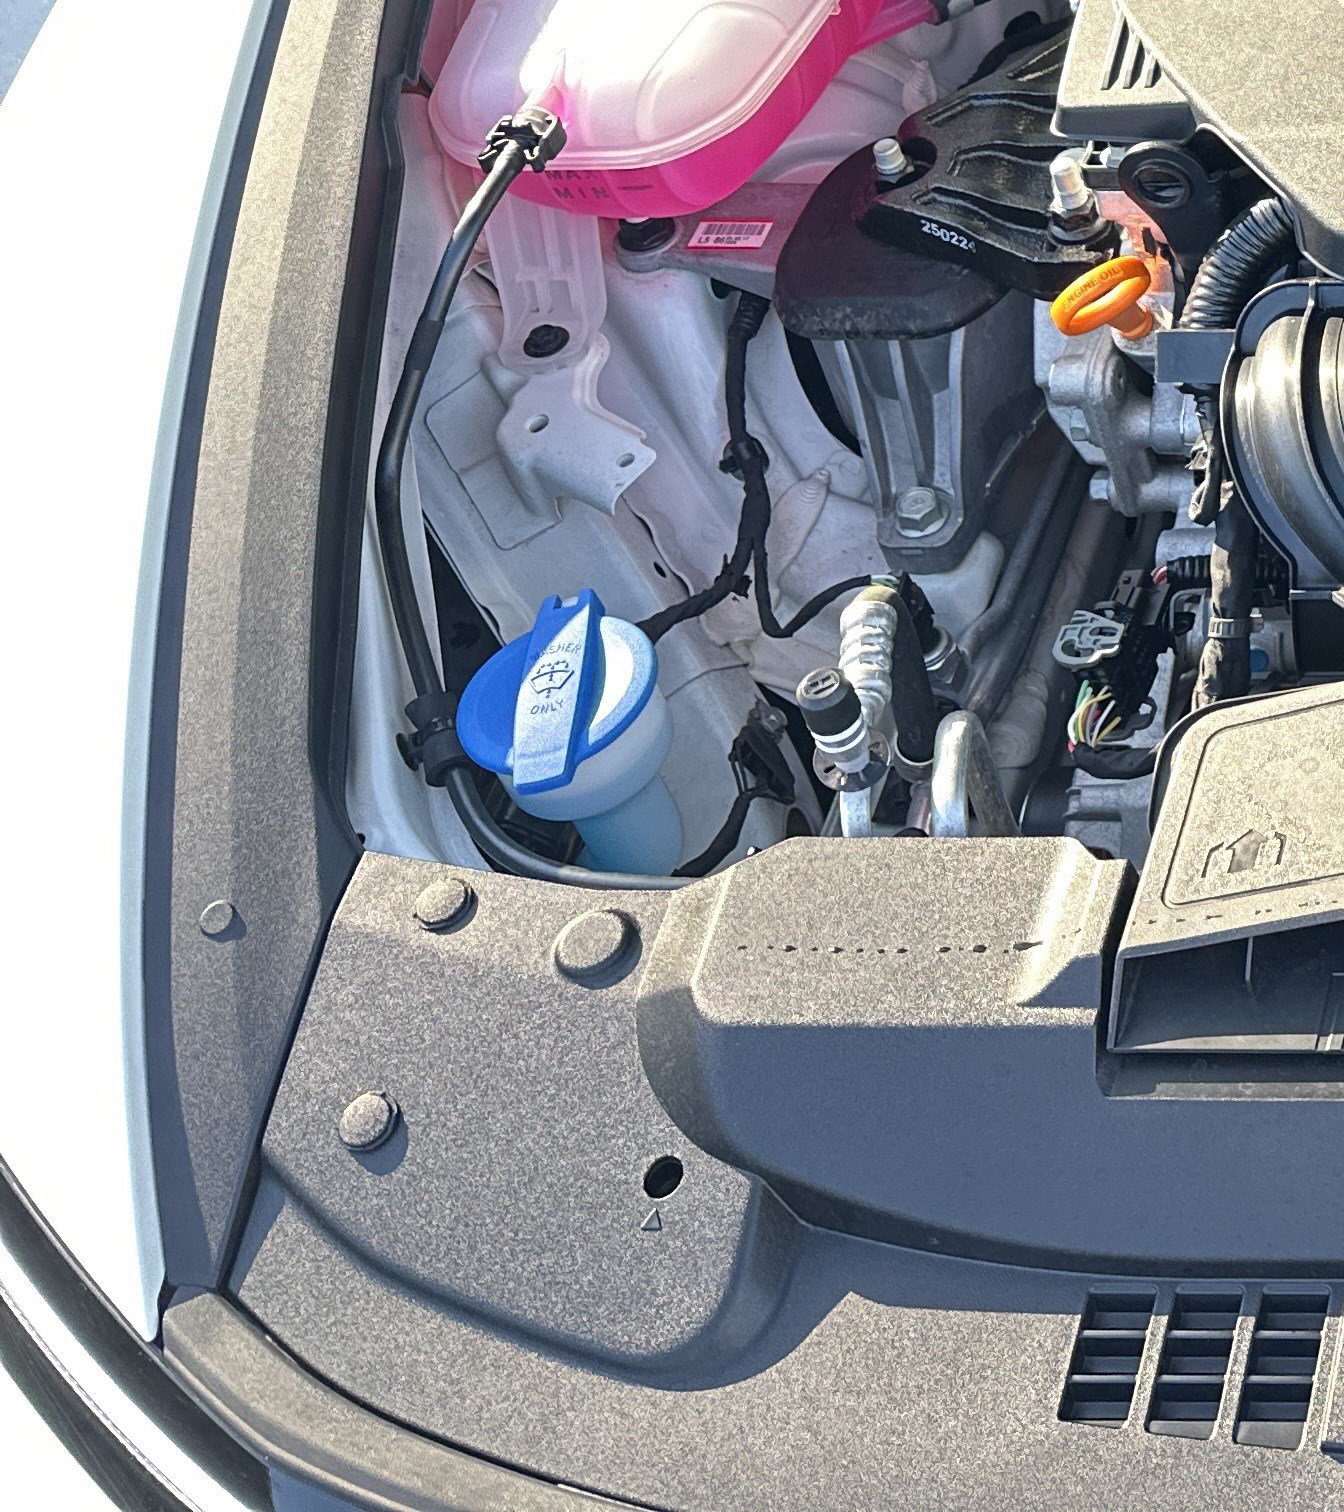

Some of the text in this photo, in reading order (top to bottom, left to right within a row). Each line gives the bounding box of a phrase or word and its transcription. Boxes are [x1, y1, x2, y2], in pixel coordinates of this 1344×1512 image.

[552, 187, 610, 200] MIN
[1062, 264, 1124, 310] ENGINE OIL
[529, 699, 564, 715] ONLY
